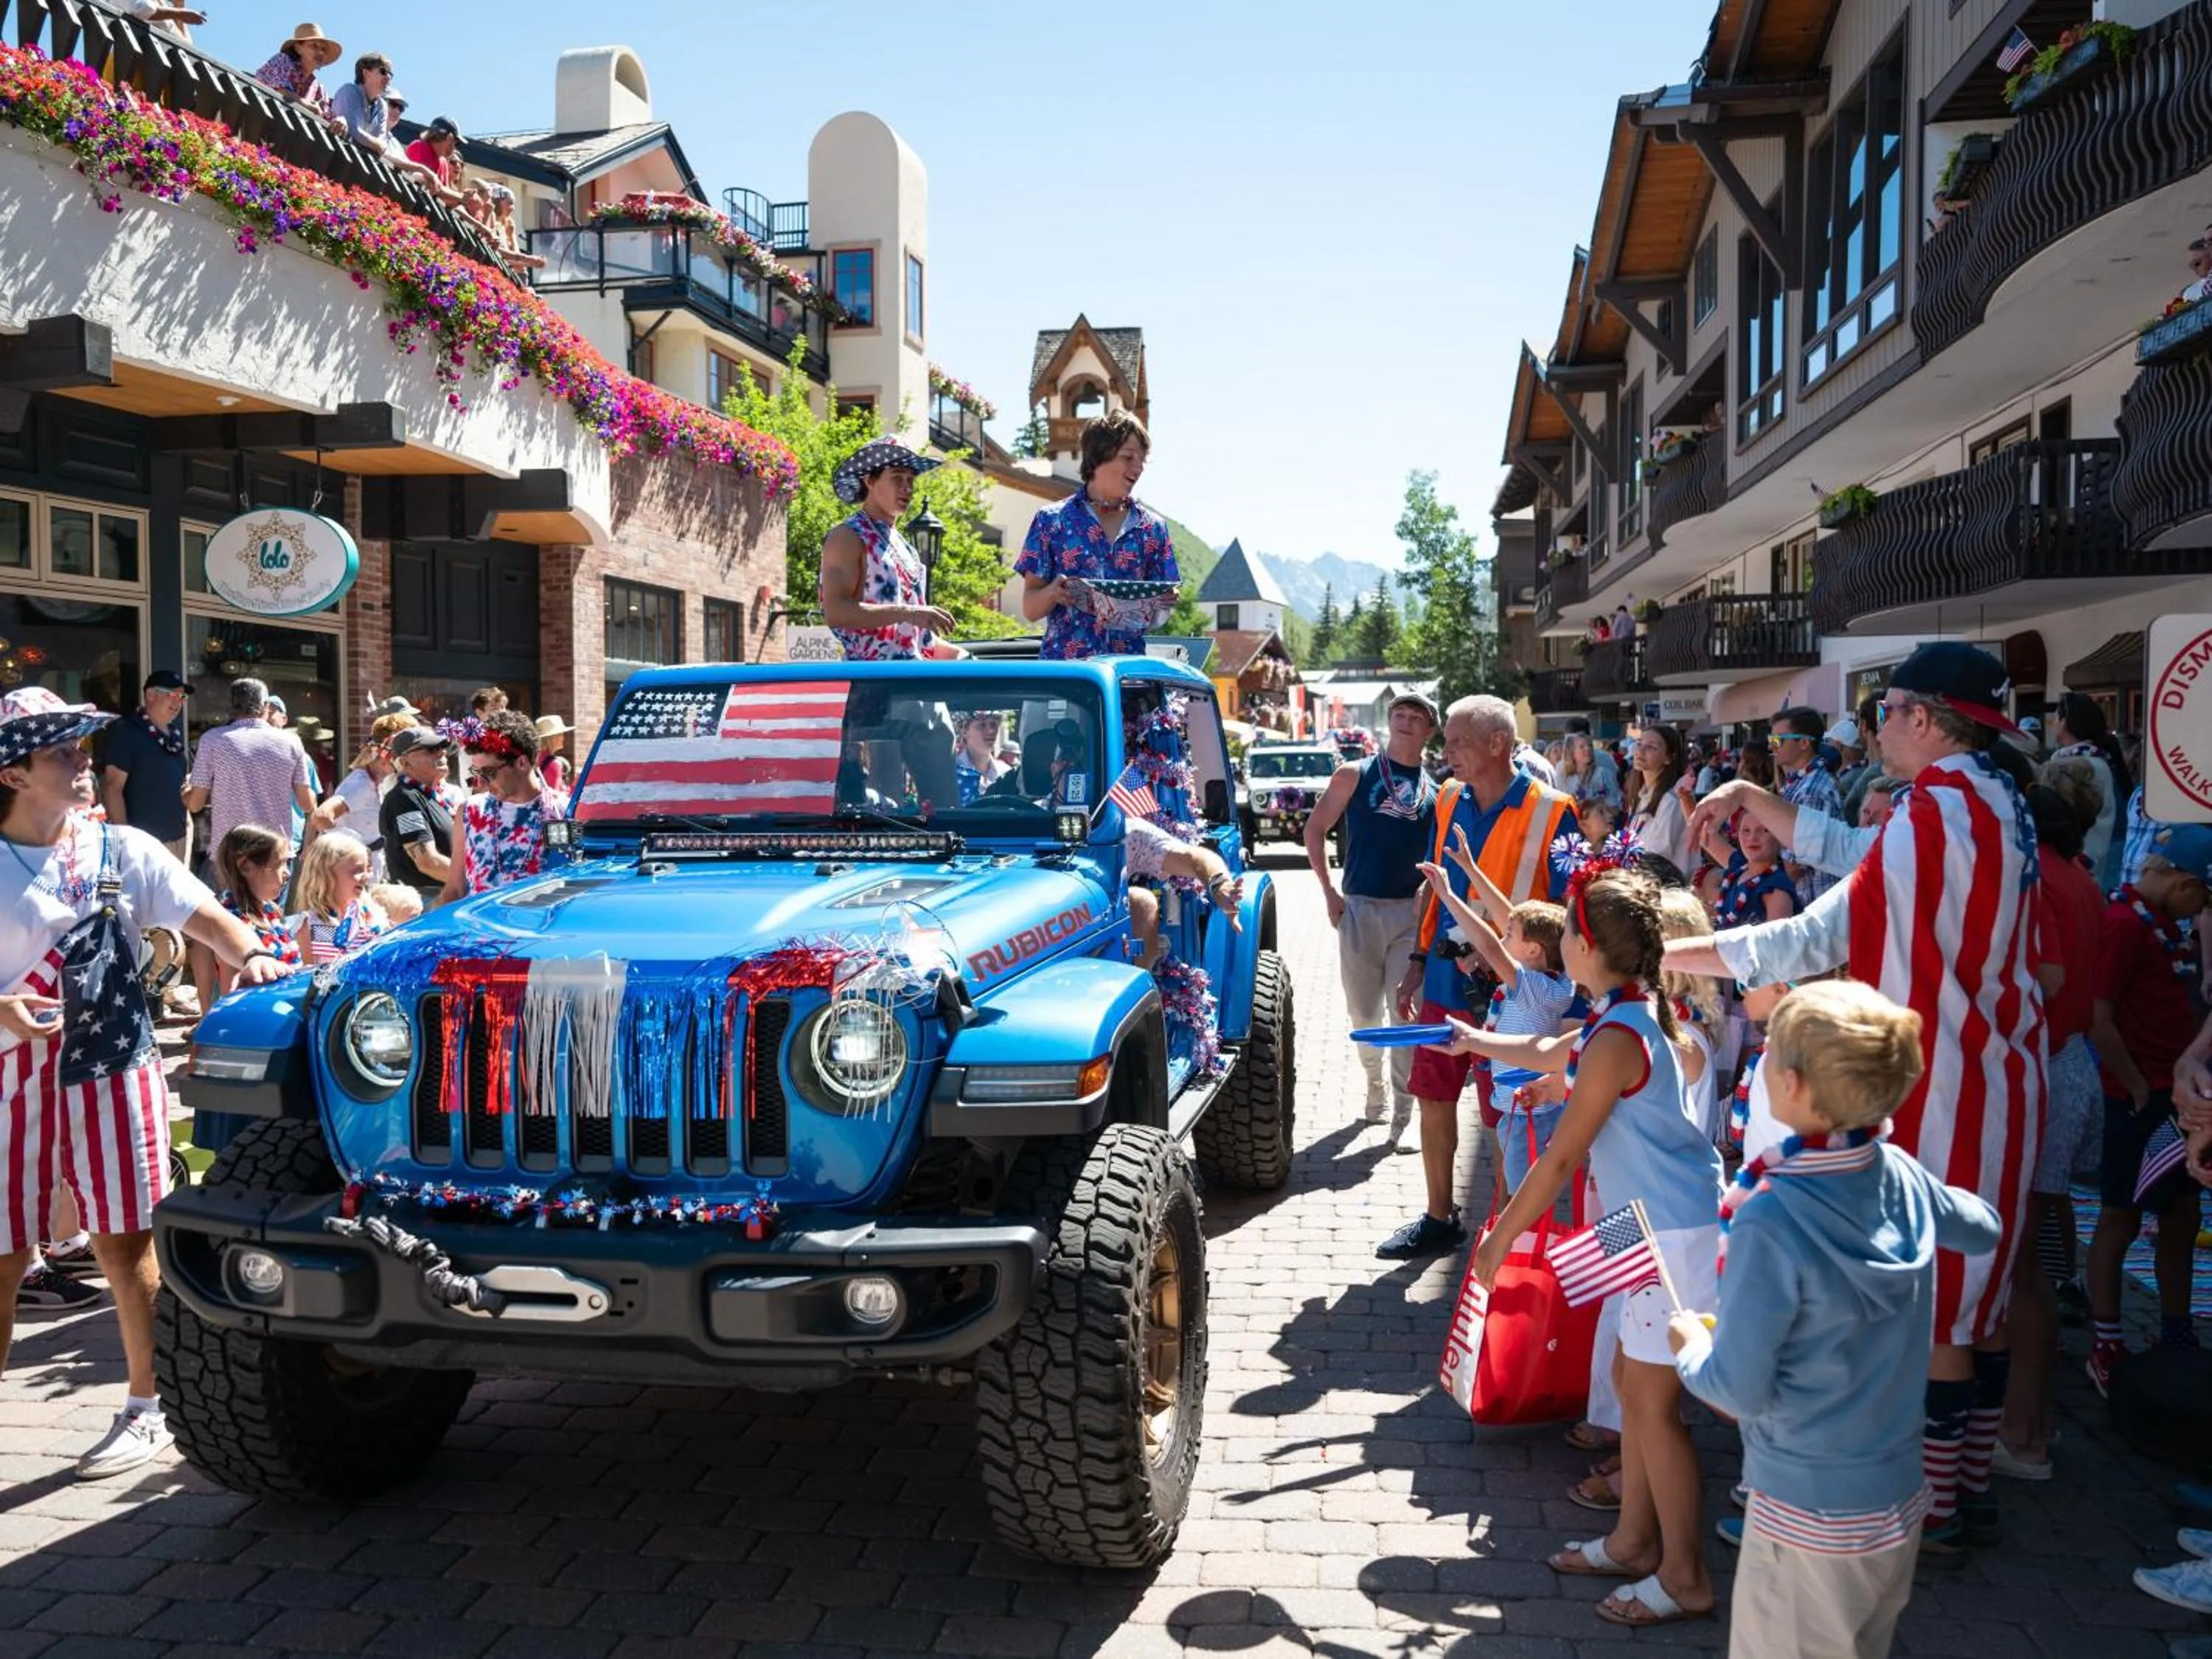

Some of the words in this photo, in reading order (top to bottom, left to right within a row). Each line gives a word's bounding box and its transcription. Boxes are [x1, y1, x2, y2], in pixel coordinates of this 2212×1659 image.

[260, 541, 290, 569] lolo
[790, 647, 838, 660] GARDENS
[796, 637, 832, 648] ALPINE
[2168, 745, 2212, 796] WALK
[967, 902, 1092, 982] RUBICON
